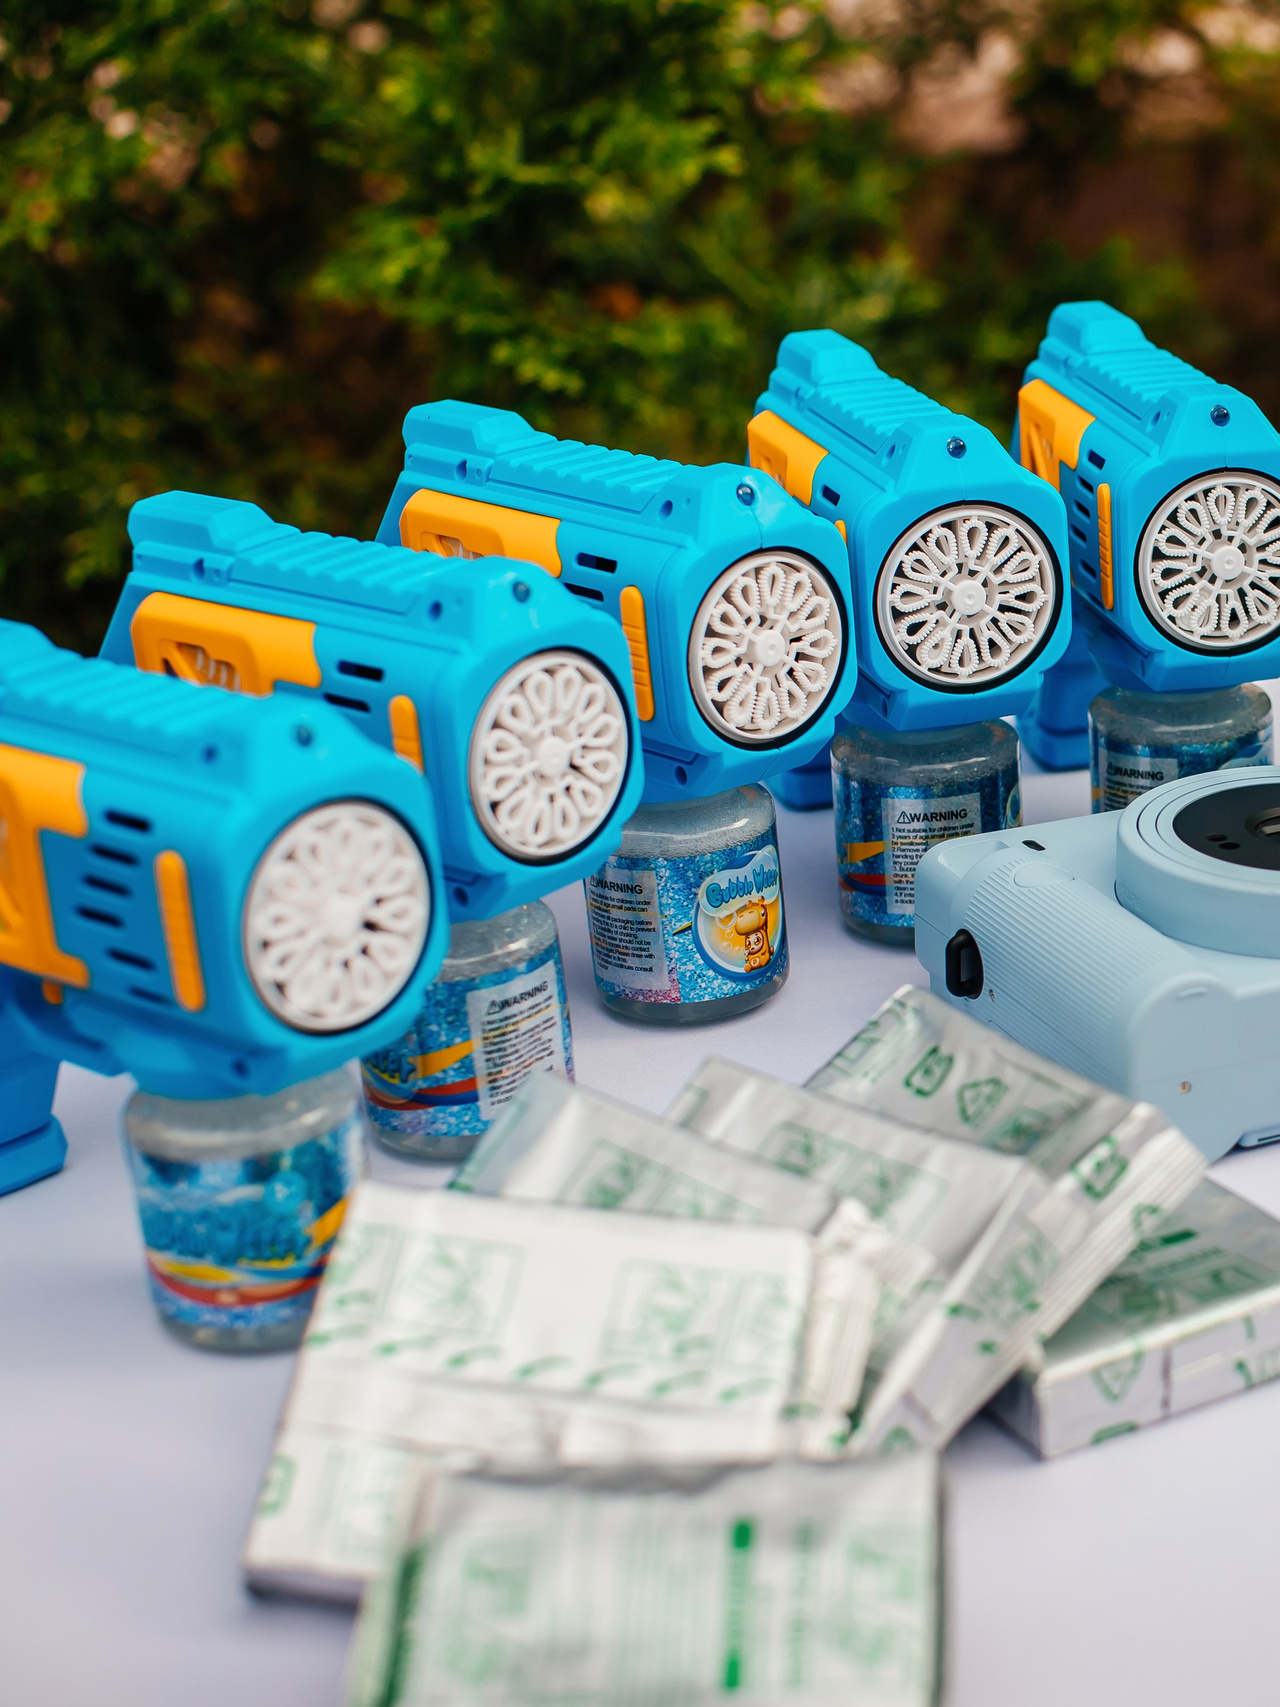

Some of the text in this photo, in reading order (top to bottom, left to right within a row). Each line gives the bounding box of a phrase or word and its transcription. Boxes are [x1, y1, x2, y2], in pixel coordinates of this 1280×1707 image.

[1113, 766, 1164, 781] WARNING
[909, 808, 968, 823] WARNING
[596, 878, 643, 894] WARNING
[706, 875, 753, 908] Bubble
